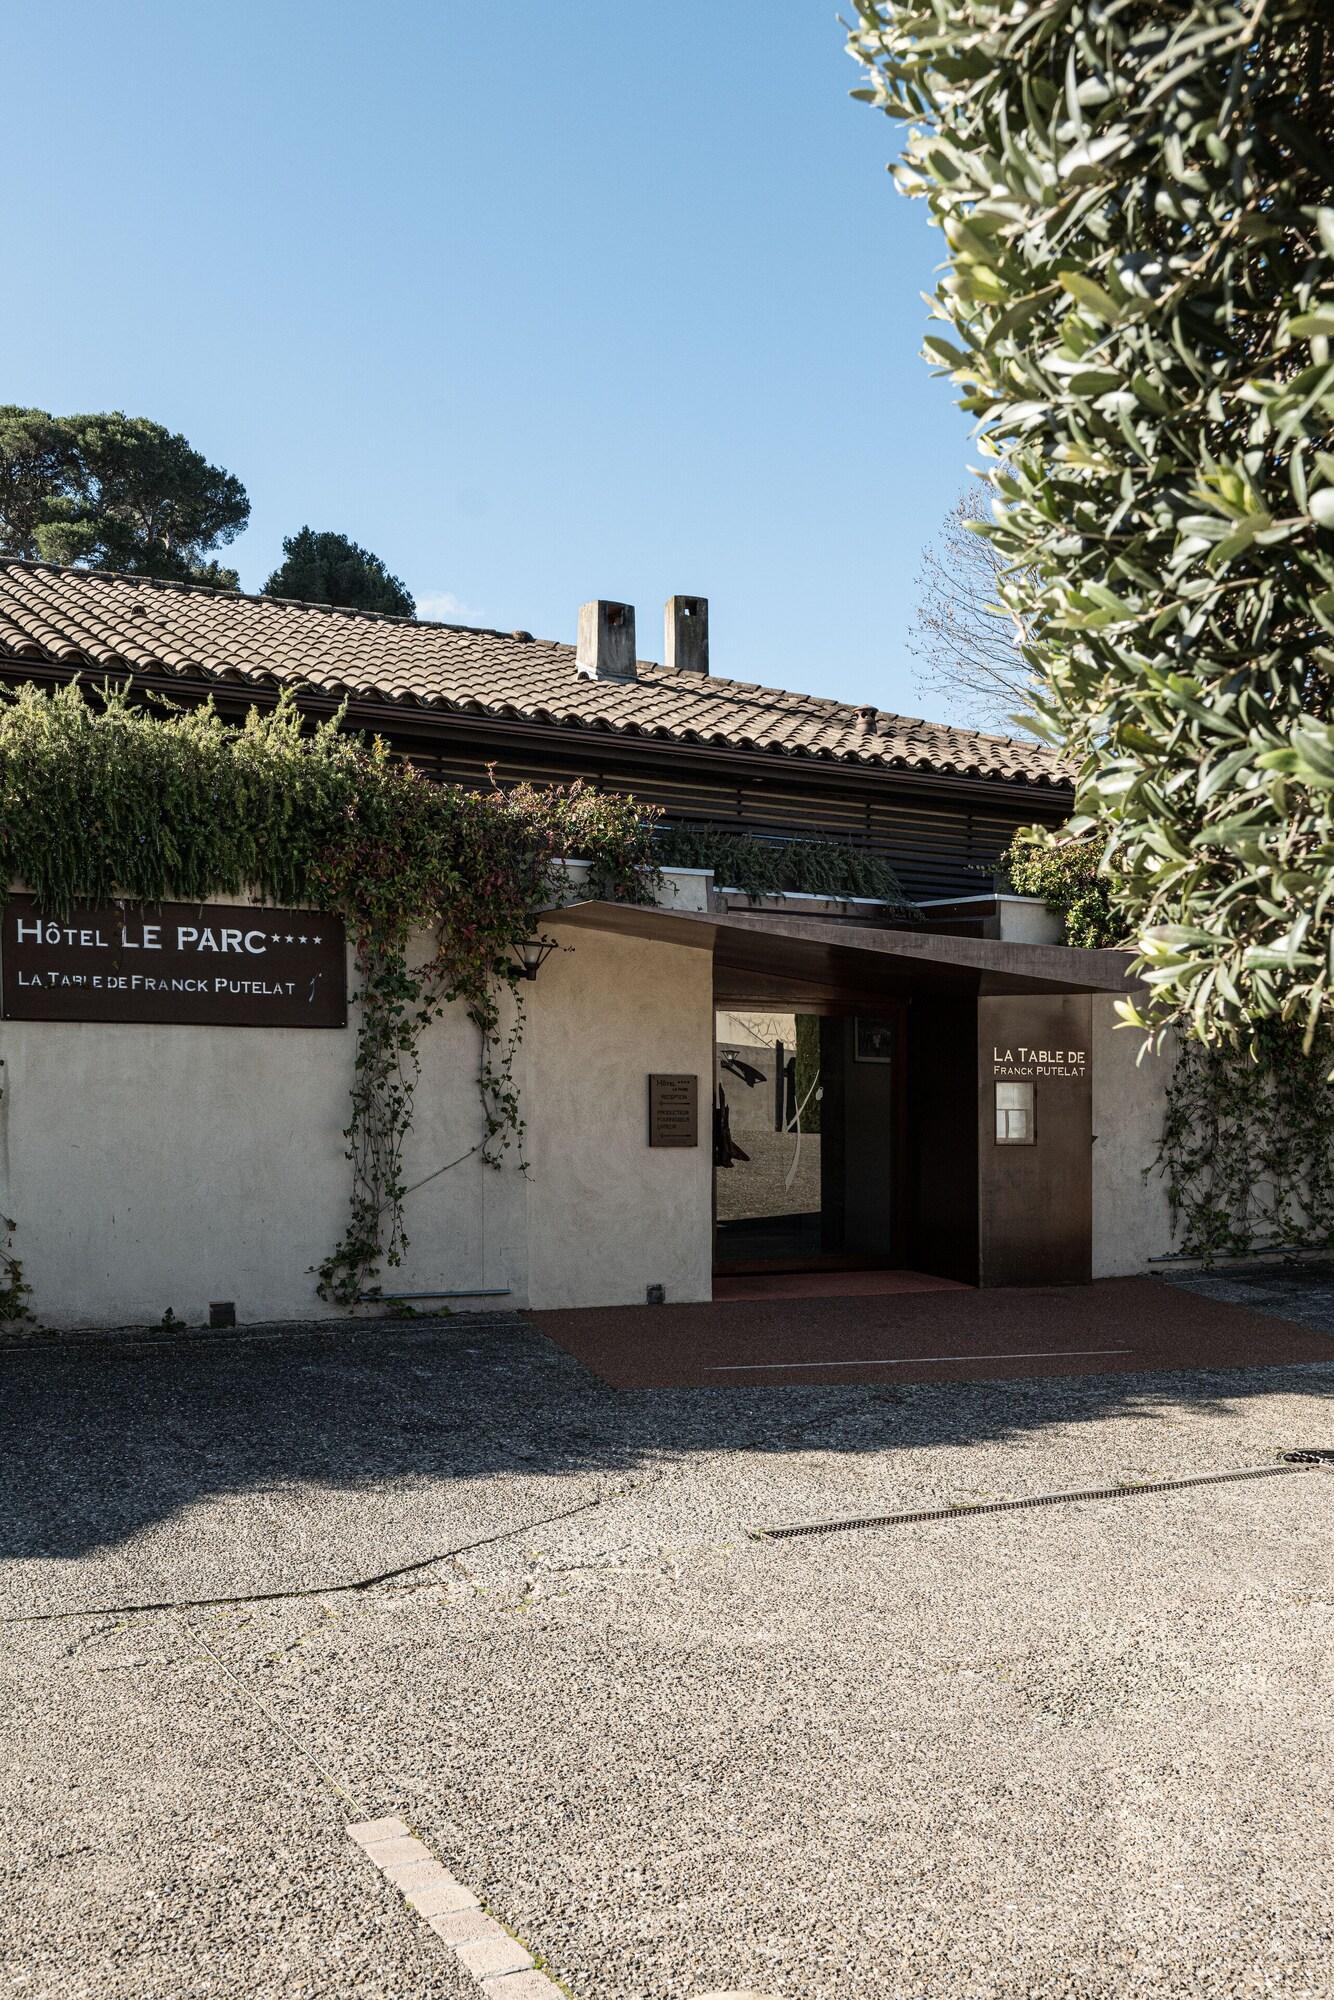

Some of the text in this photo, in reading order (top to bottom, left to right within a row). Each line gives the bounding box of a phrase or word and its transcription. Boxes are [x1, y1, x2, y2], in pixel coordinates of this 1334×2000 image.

[16, 918, 268, 954] HÔTEL LE PARC
[18, 971, 42, 987] LA
[107, 976, 129, 989] DE
[131, 974, 209, 993] FRANCK
[214, 977, 296, 996] PUTELAT
[993, 1047, 1086, 1064] LA TABLE DE
[993, 1065, 1086, 1077] FRANCK PUTELAT
